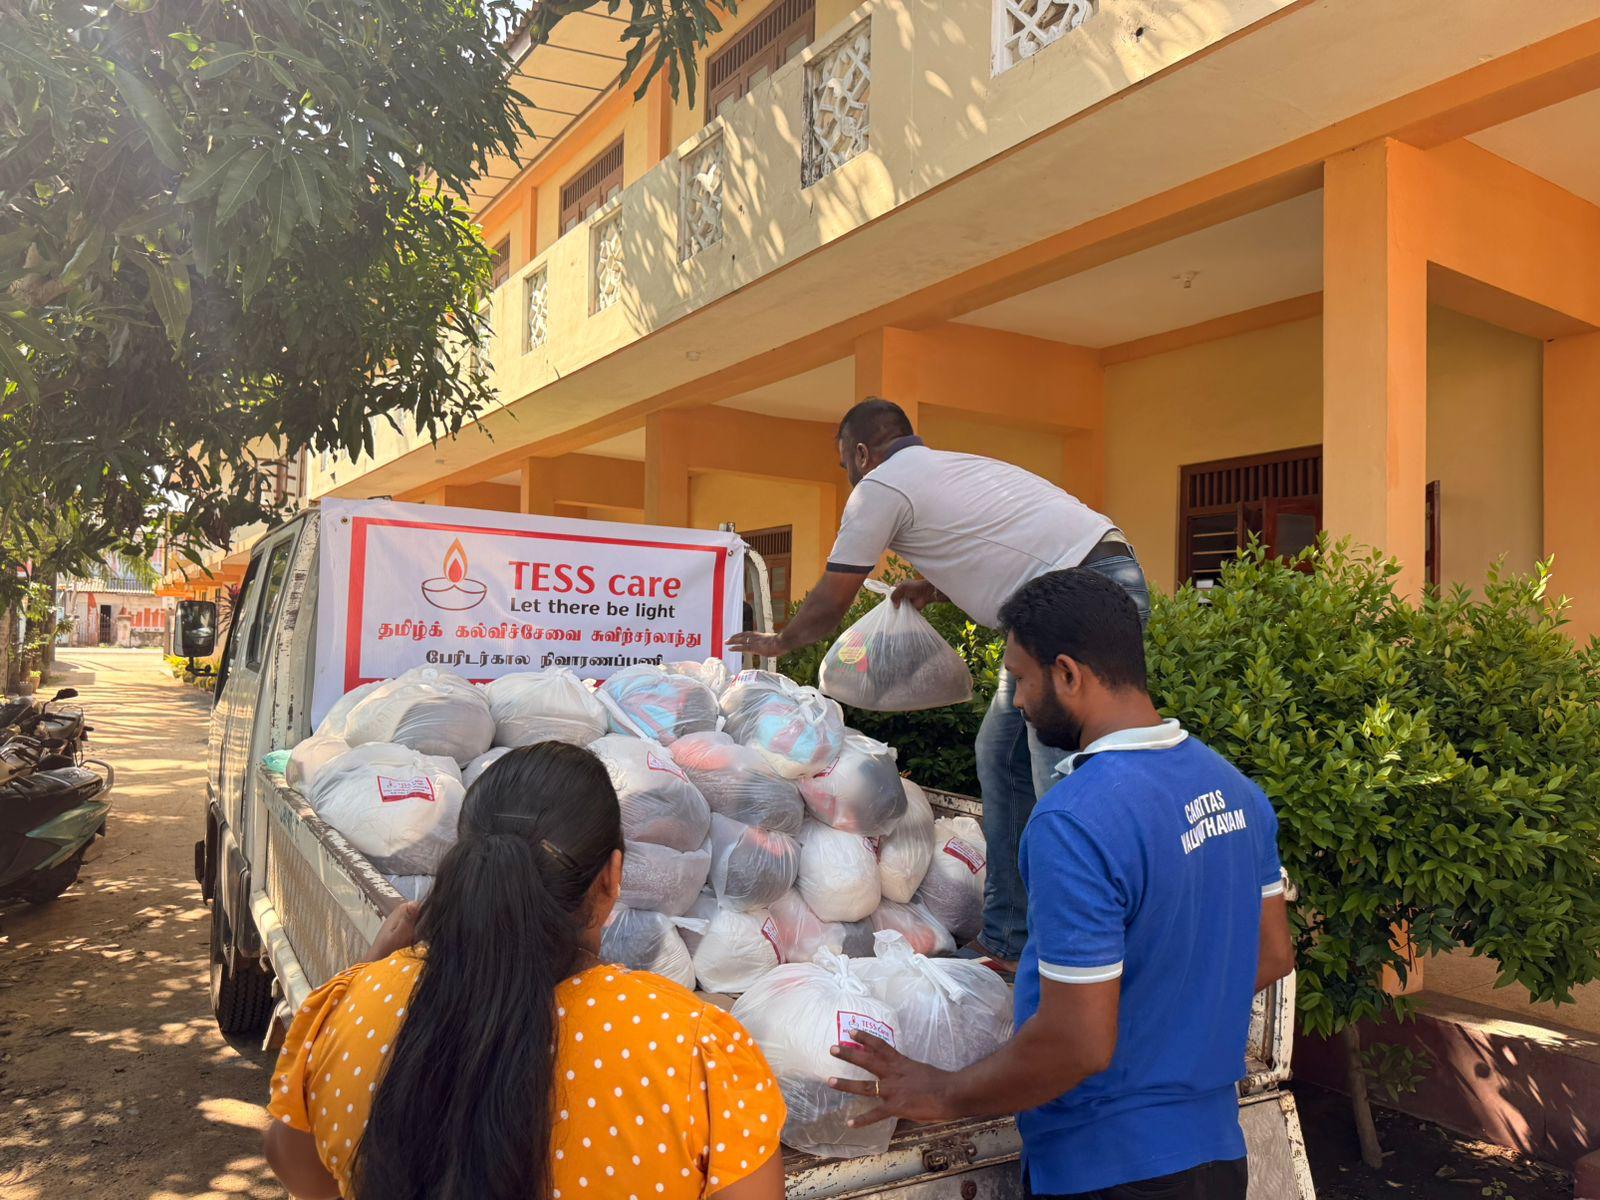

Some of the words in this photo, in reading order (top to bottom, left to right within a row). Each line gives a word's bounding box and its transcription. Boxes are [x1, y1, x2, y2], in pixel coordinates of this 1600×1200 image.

[508, 560, 596, 595] TESS
[608, 574, 682, 599] care
[510, 597, 541, 613] Let
[549, 599, 600, 616] there
[606, 601, 629, 617] be
[635, 602, 675, 620] light
[378, 618, 444, 641] தமிழ்க்
[455, 622, 582, 642] கல்விச்சேவை
[591, 626, 702, 647] சுவிற்சர்லாந்து
[425, 649, 531, 667] பேரிடர்கால
[540, 652, 663, 668] நிவாரணப்பணி
[1184, 789, 1226, 825] CARITAS
